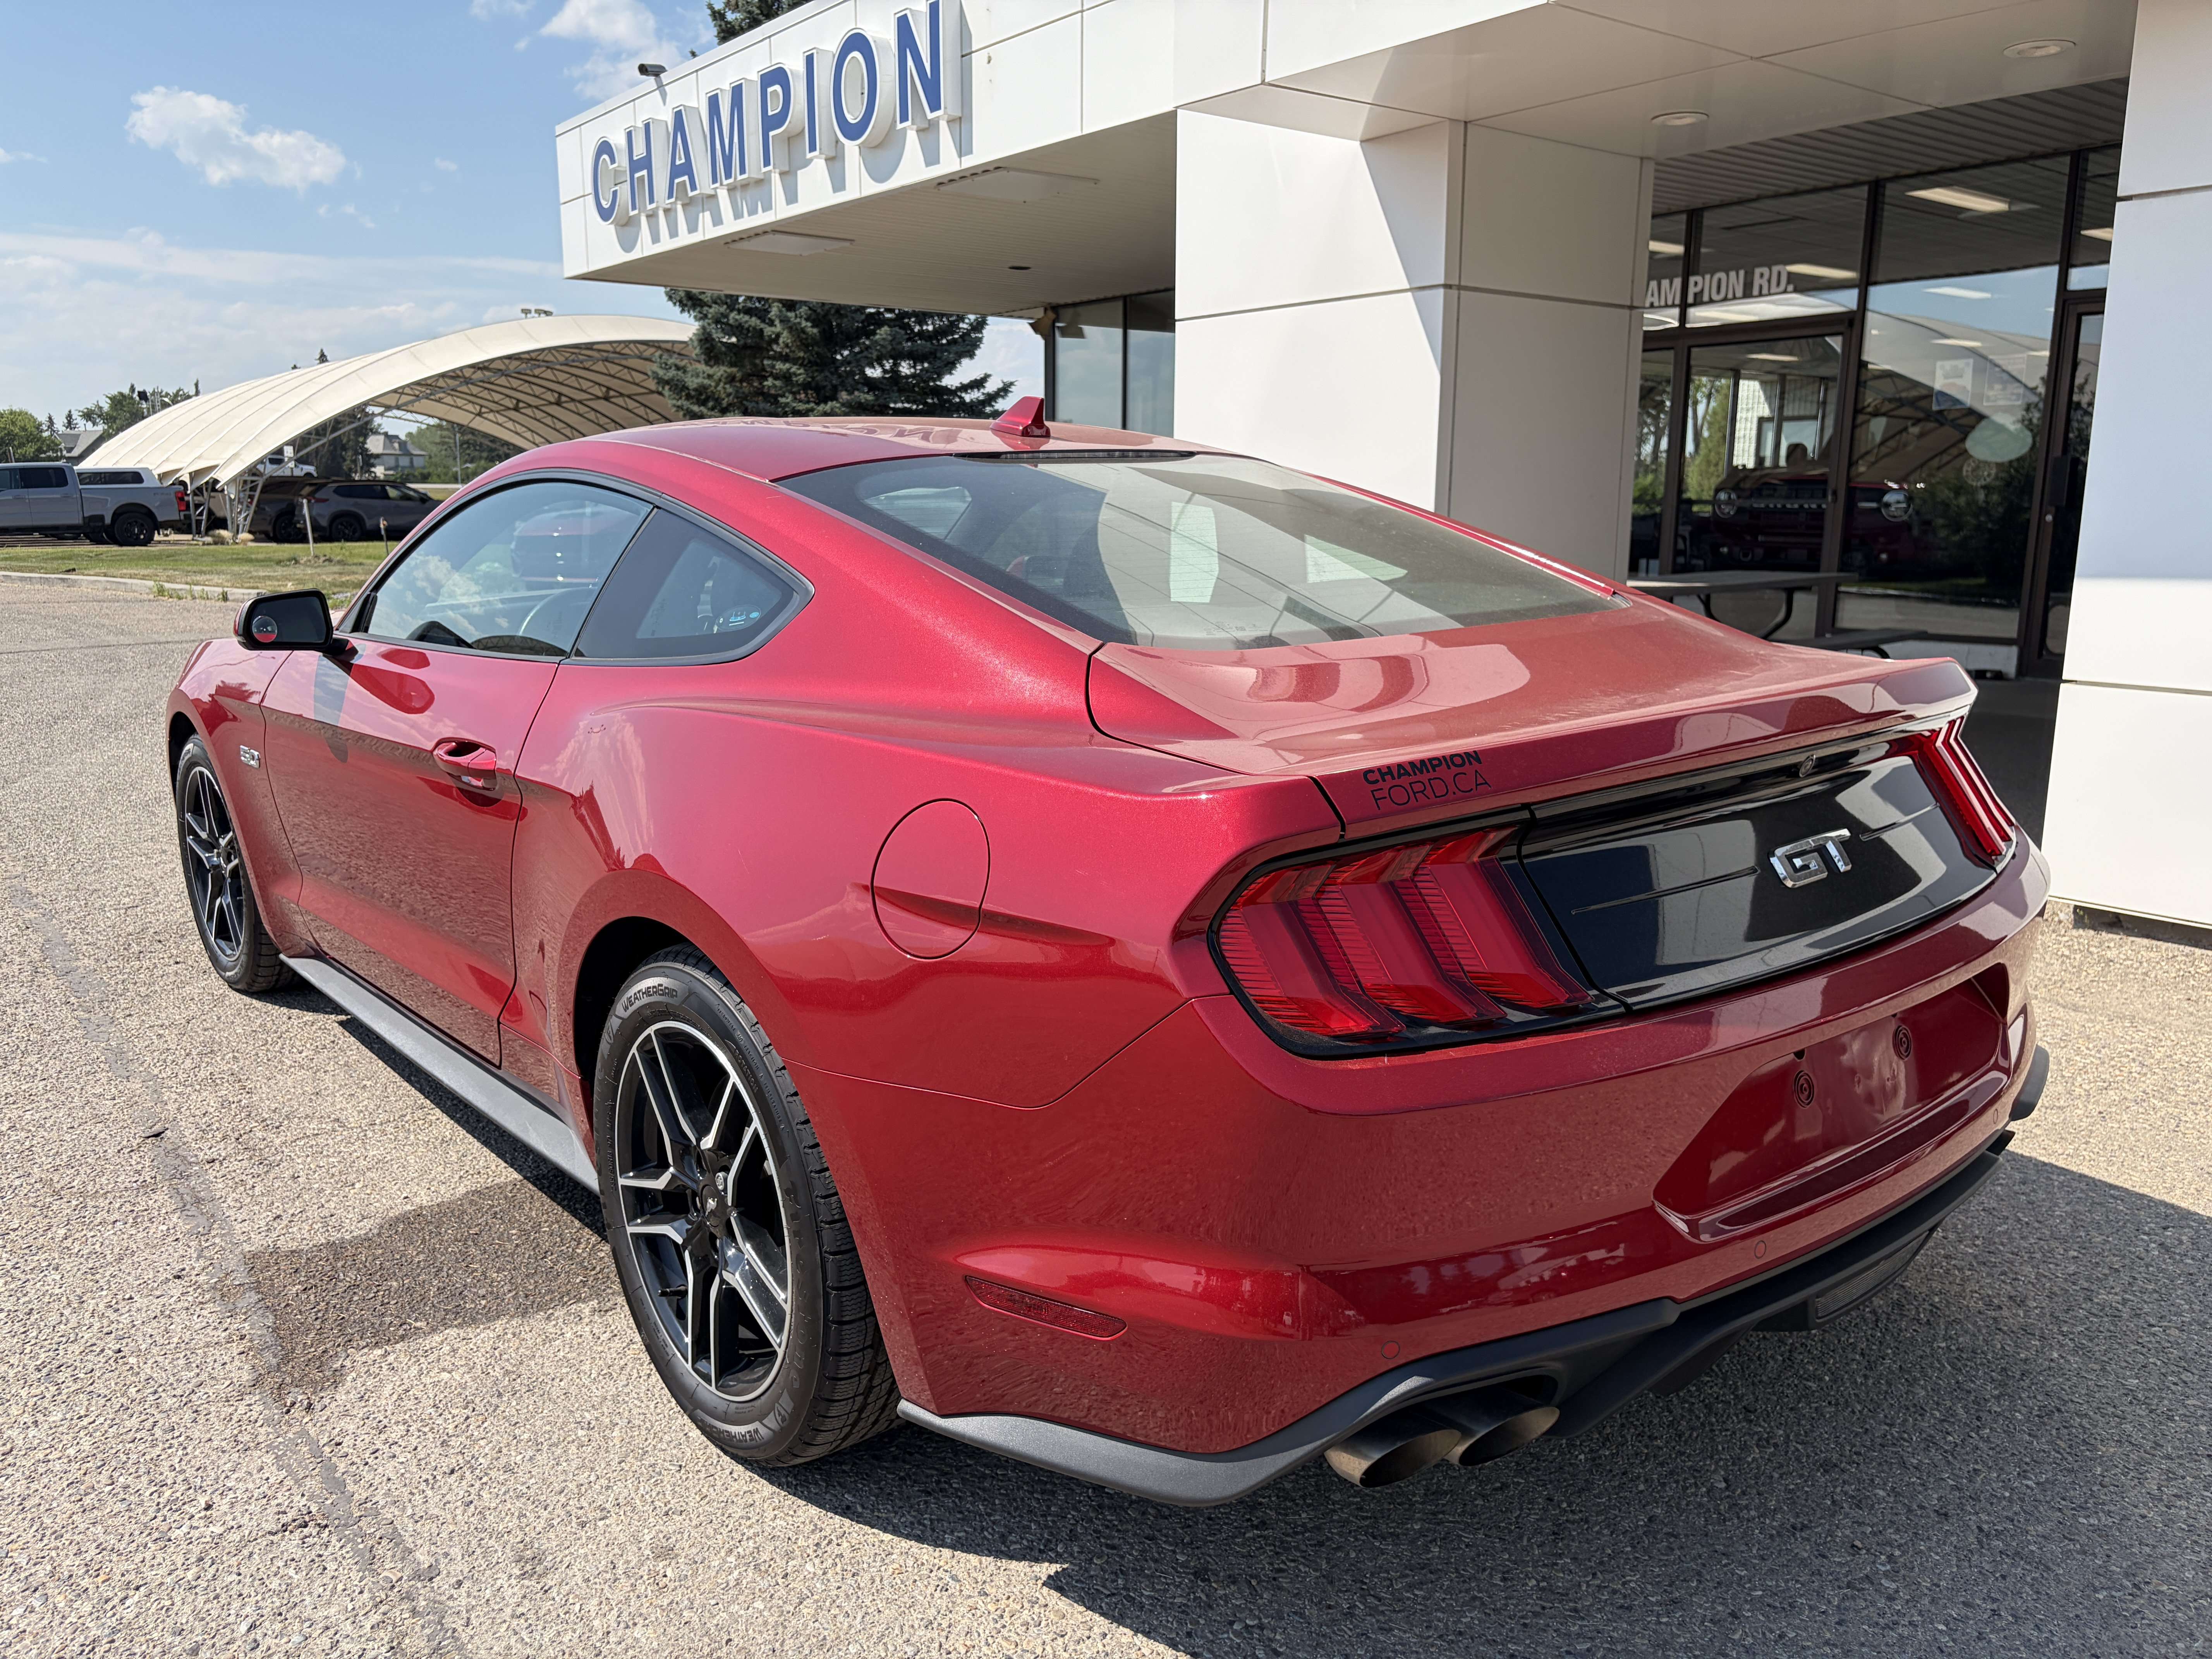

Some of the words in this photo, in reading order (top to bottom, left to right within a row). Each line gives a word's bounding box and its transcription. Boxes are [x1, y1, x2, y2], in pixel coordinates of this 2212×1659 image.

[591, 0, 944, 226] CHAMPION
[1752, 265, 1794, 296] RD.
[1363, 750, 1482, 785] CHAMPION
[1370, 769, 1492, 811] FORD.CA
[1768, 828, 1852, 889] GT
